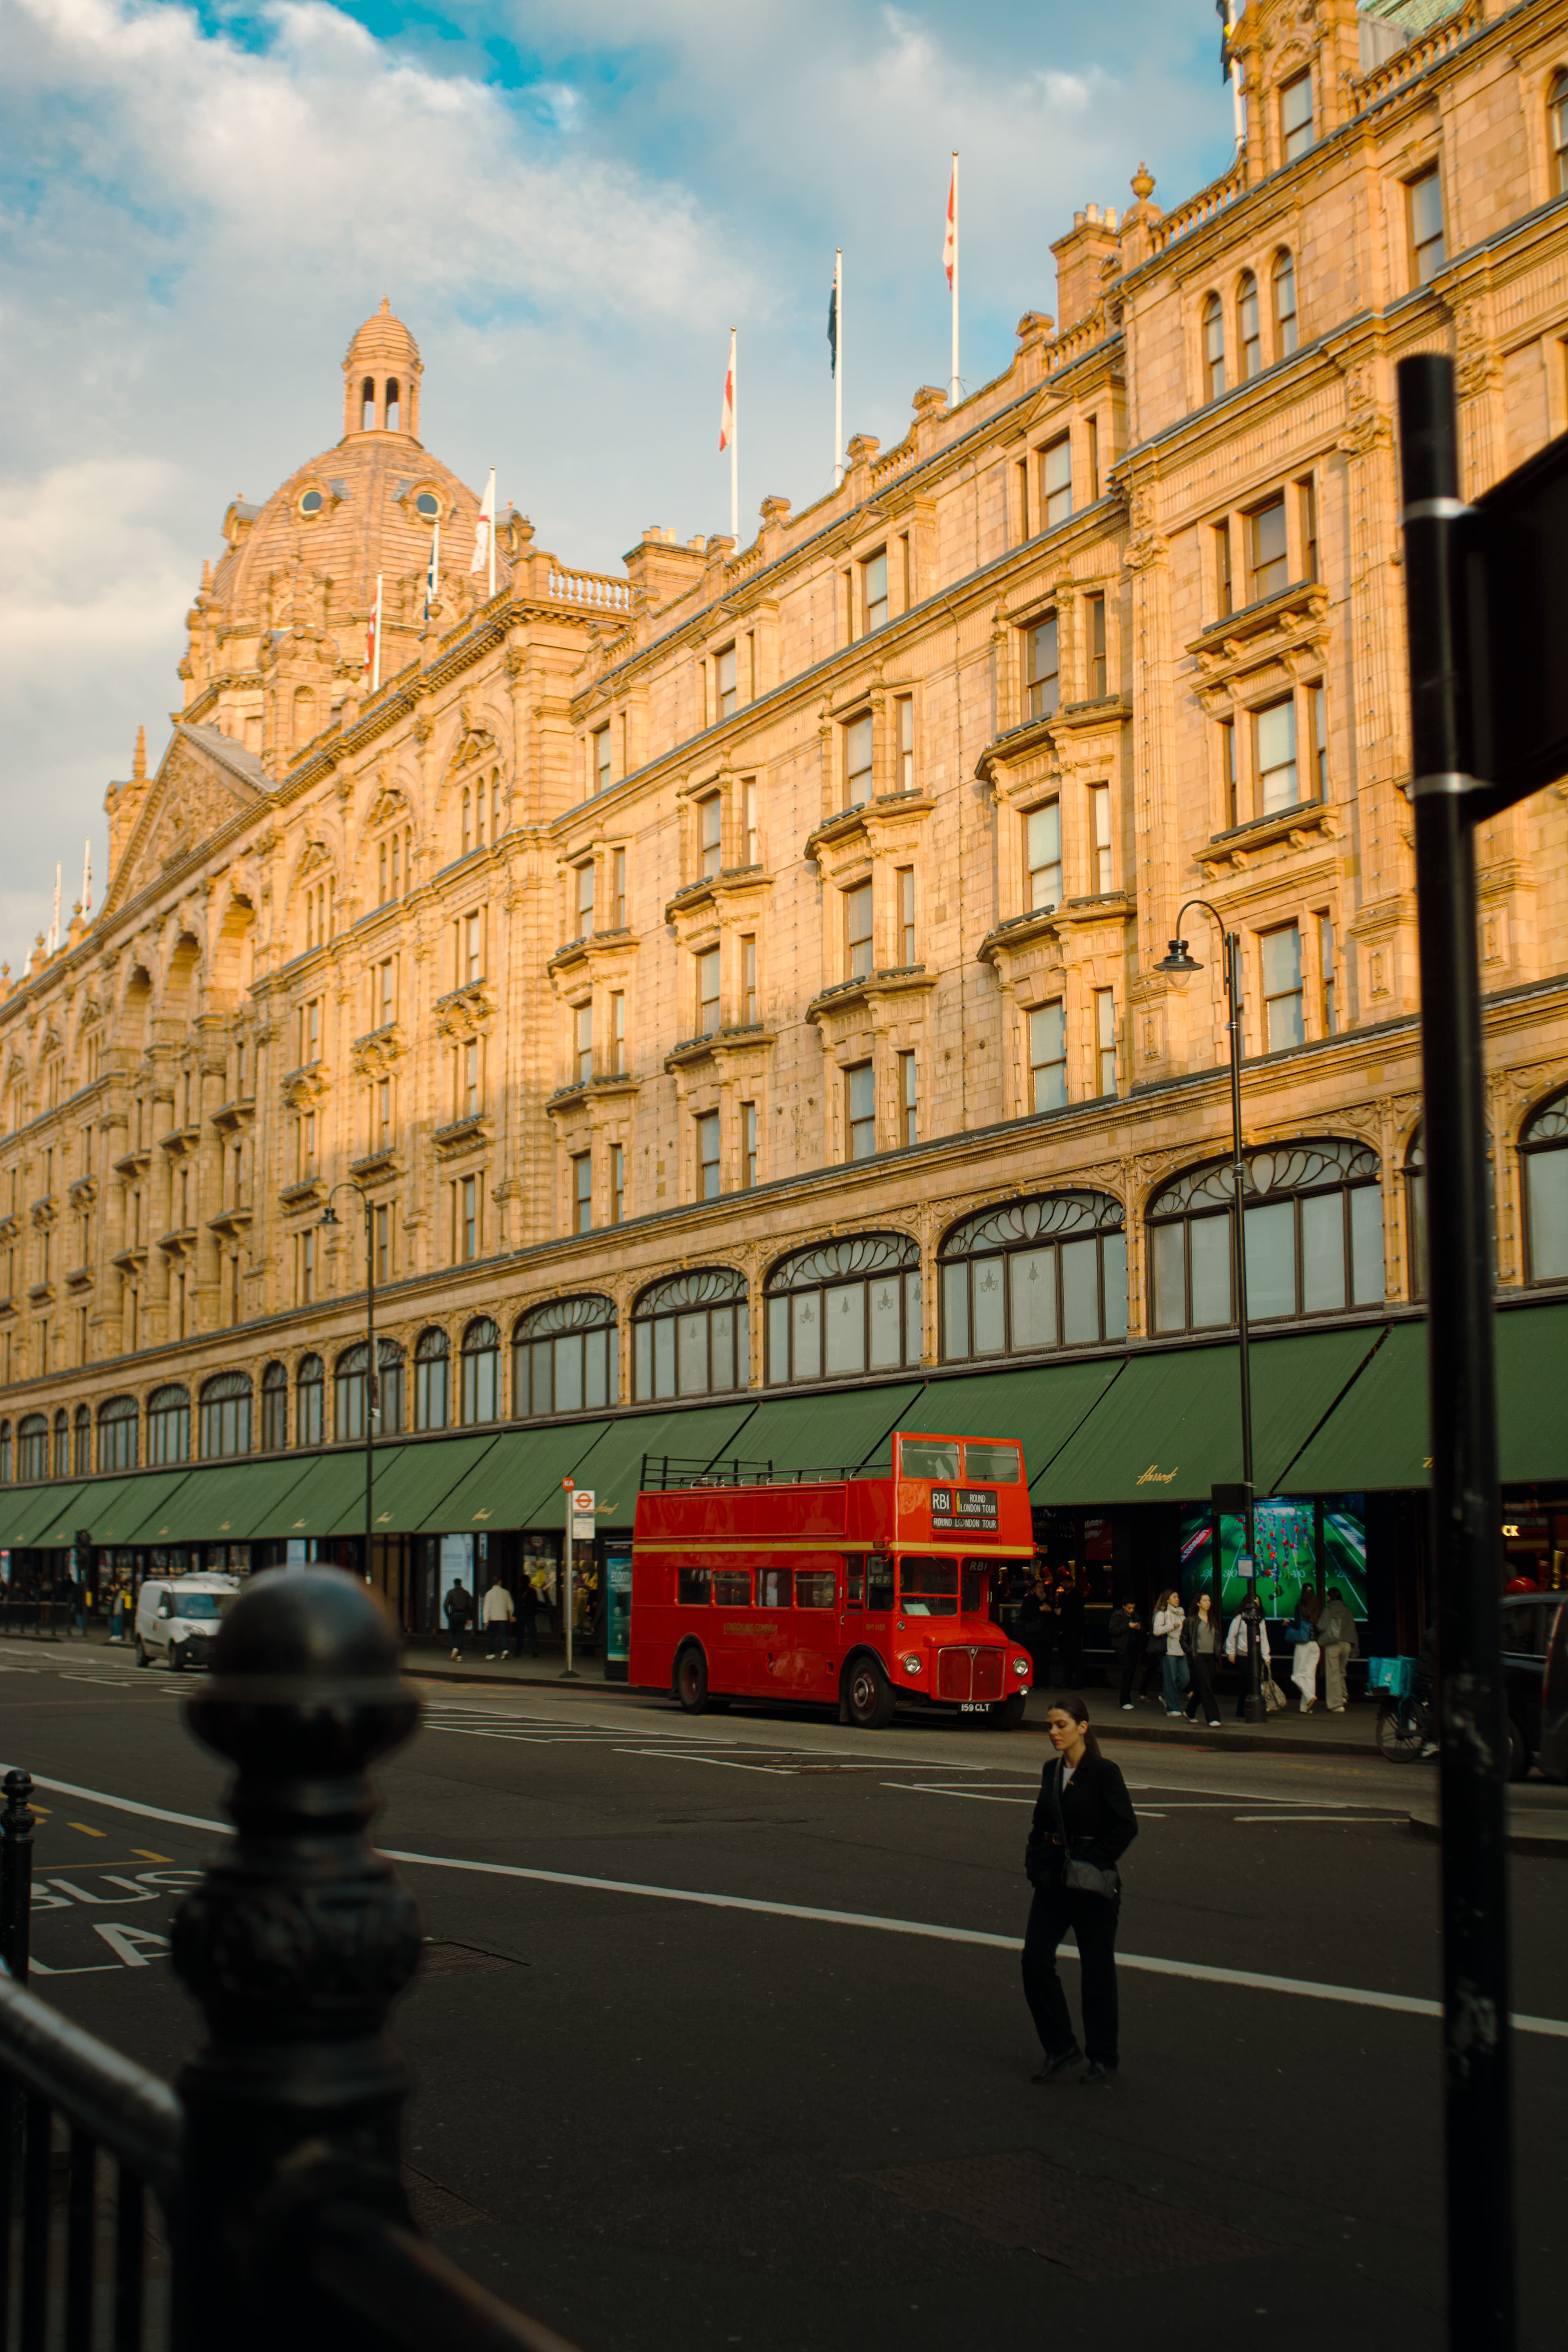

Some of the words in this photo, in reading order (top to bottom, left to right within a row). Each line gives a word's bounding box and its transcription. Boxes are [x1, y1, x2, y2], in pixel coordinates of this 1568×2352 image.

[1136, 1464, 1178, 1485] Harrods
[969, 1494, 986, 1503] ROUND
[960, 1503, 981, 1513] LONDON
[982, 1504, 996, 1513] TOUR
[933, 1517, 952, 1527] ROUND
[955, 1518, 980, 1528] LONDON
[982, 1519, 996, 1528] TOUR
[961, 1703, 974, 1711] 159
[975, 1703, 990, 1711] CLT
